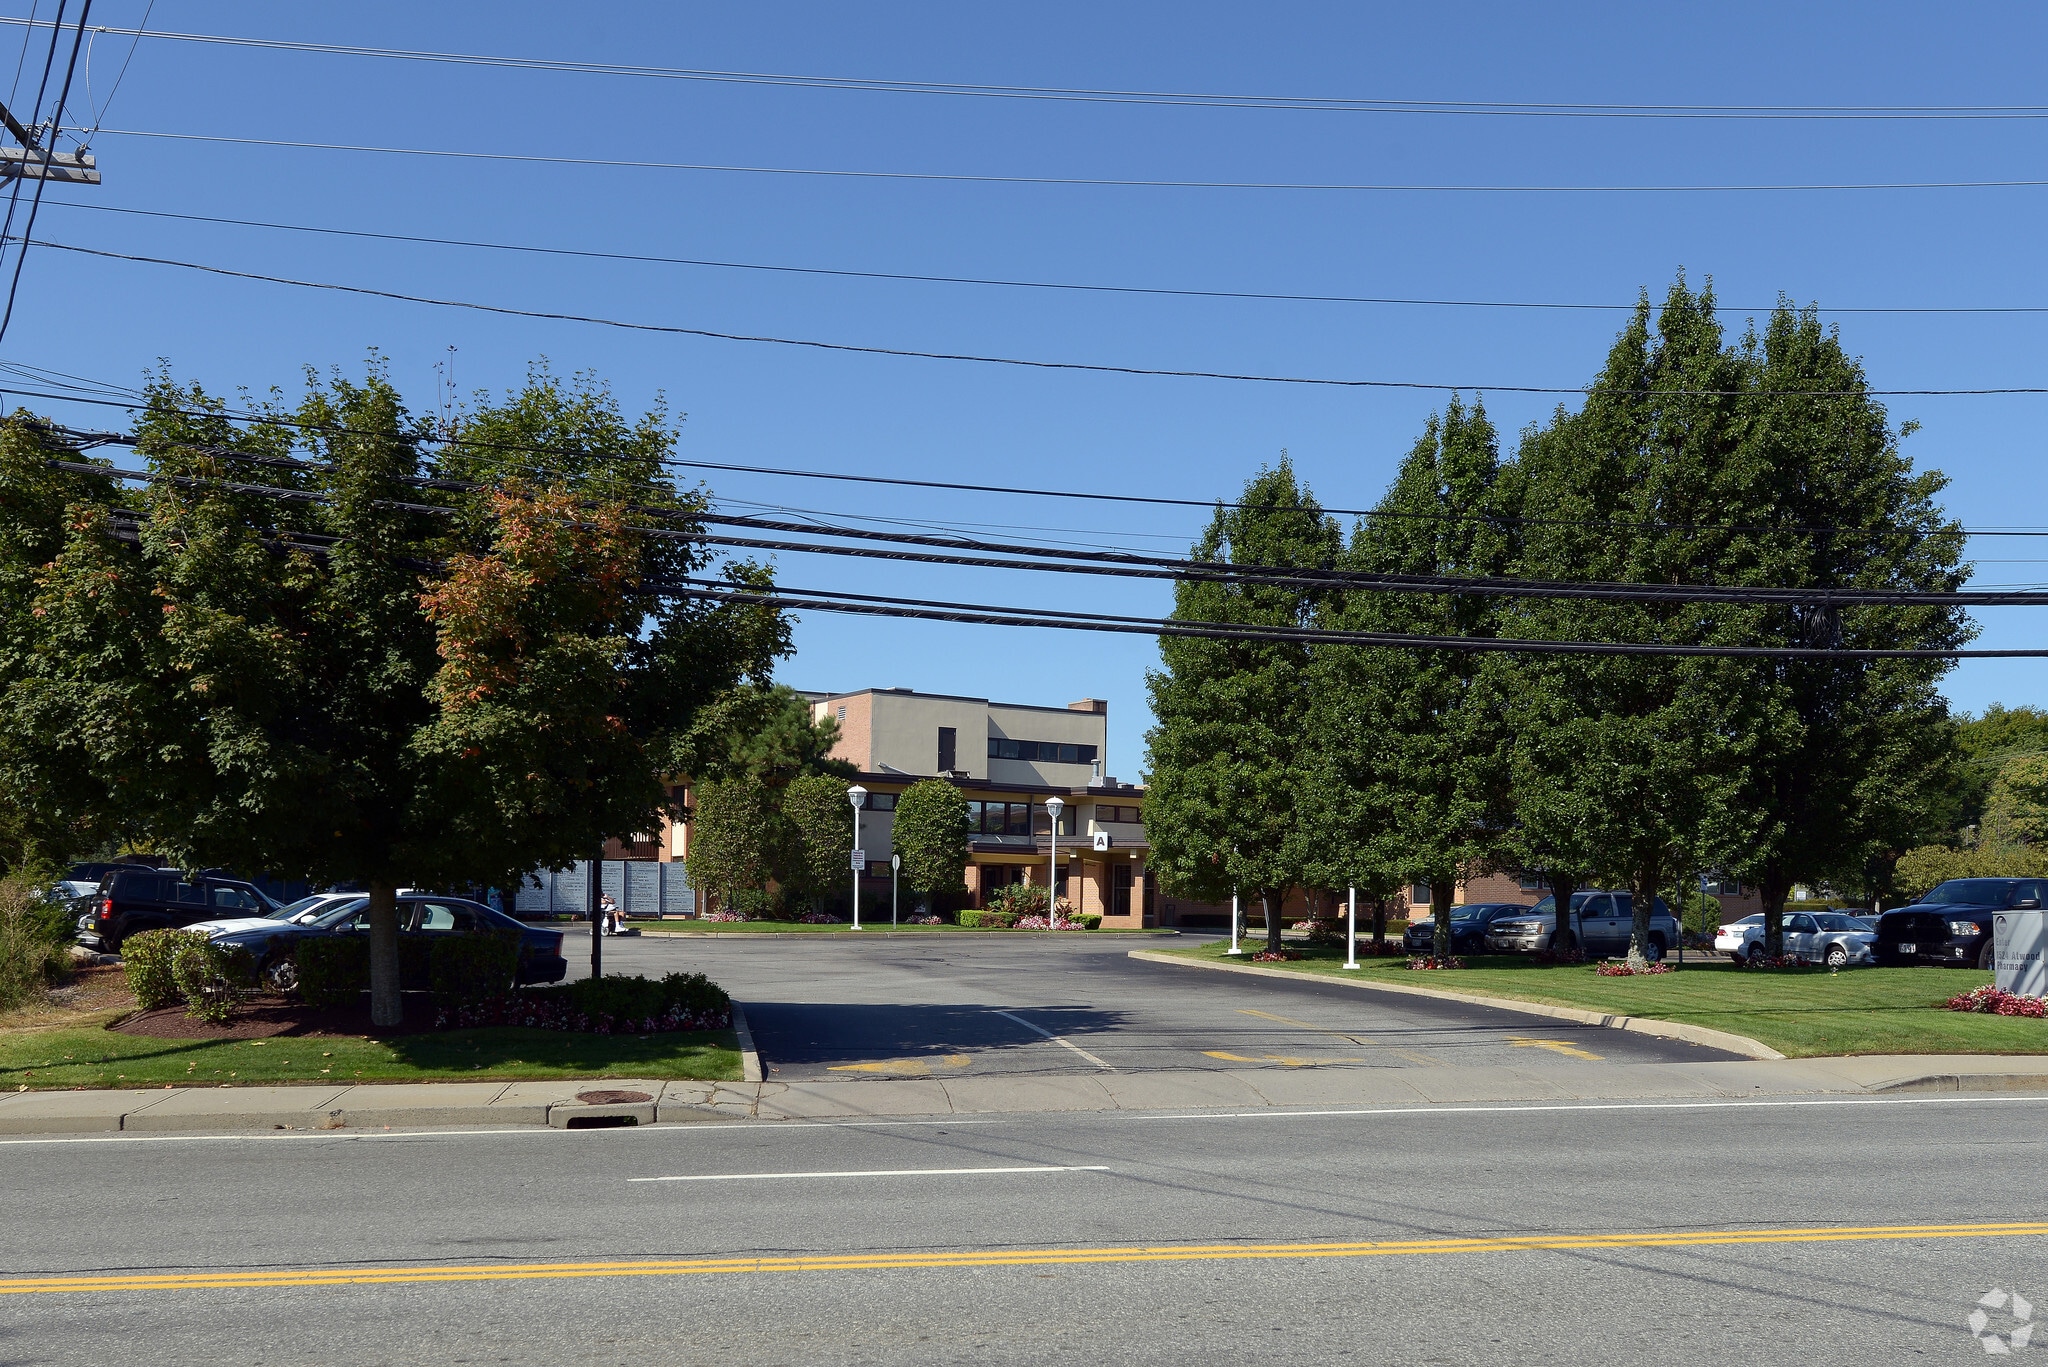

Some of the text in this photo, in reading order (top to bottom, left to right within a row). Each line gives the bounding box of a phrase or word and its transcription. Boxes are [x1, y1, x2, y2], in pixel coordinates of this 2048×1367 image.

[1096, 836, 1105, 846] A
[2012, 951, 2040, 960] Atwood
[1997, 961, 2028, 972] Pharmacy
